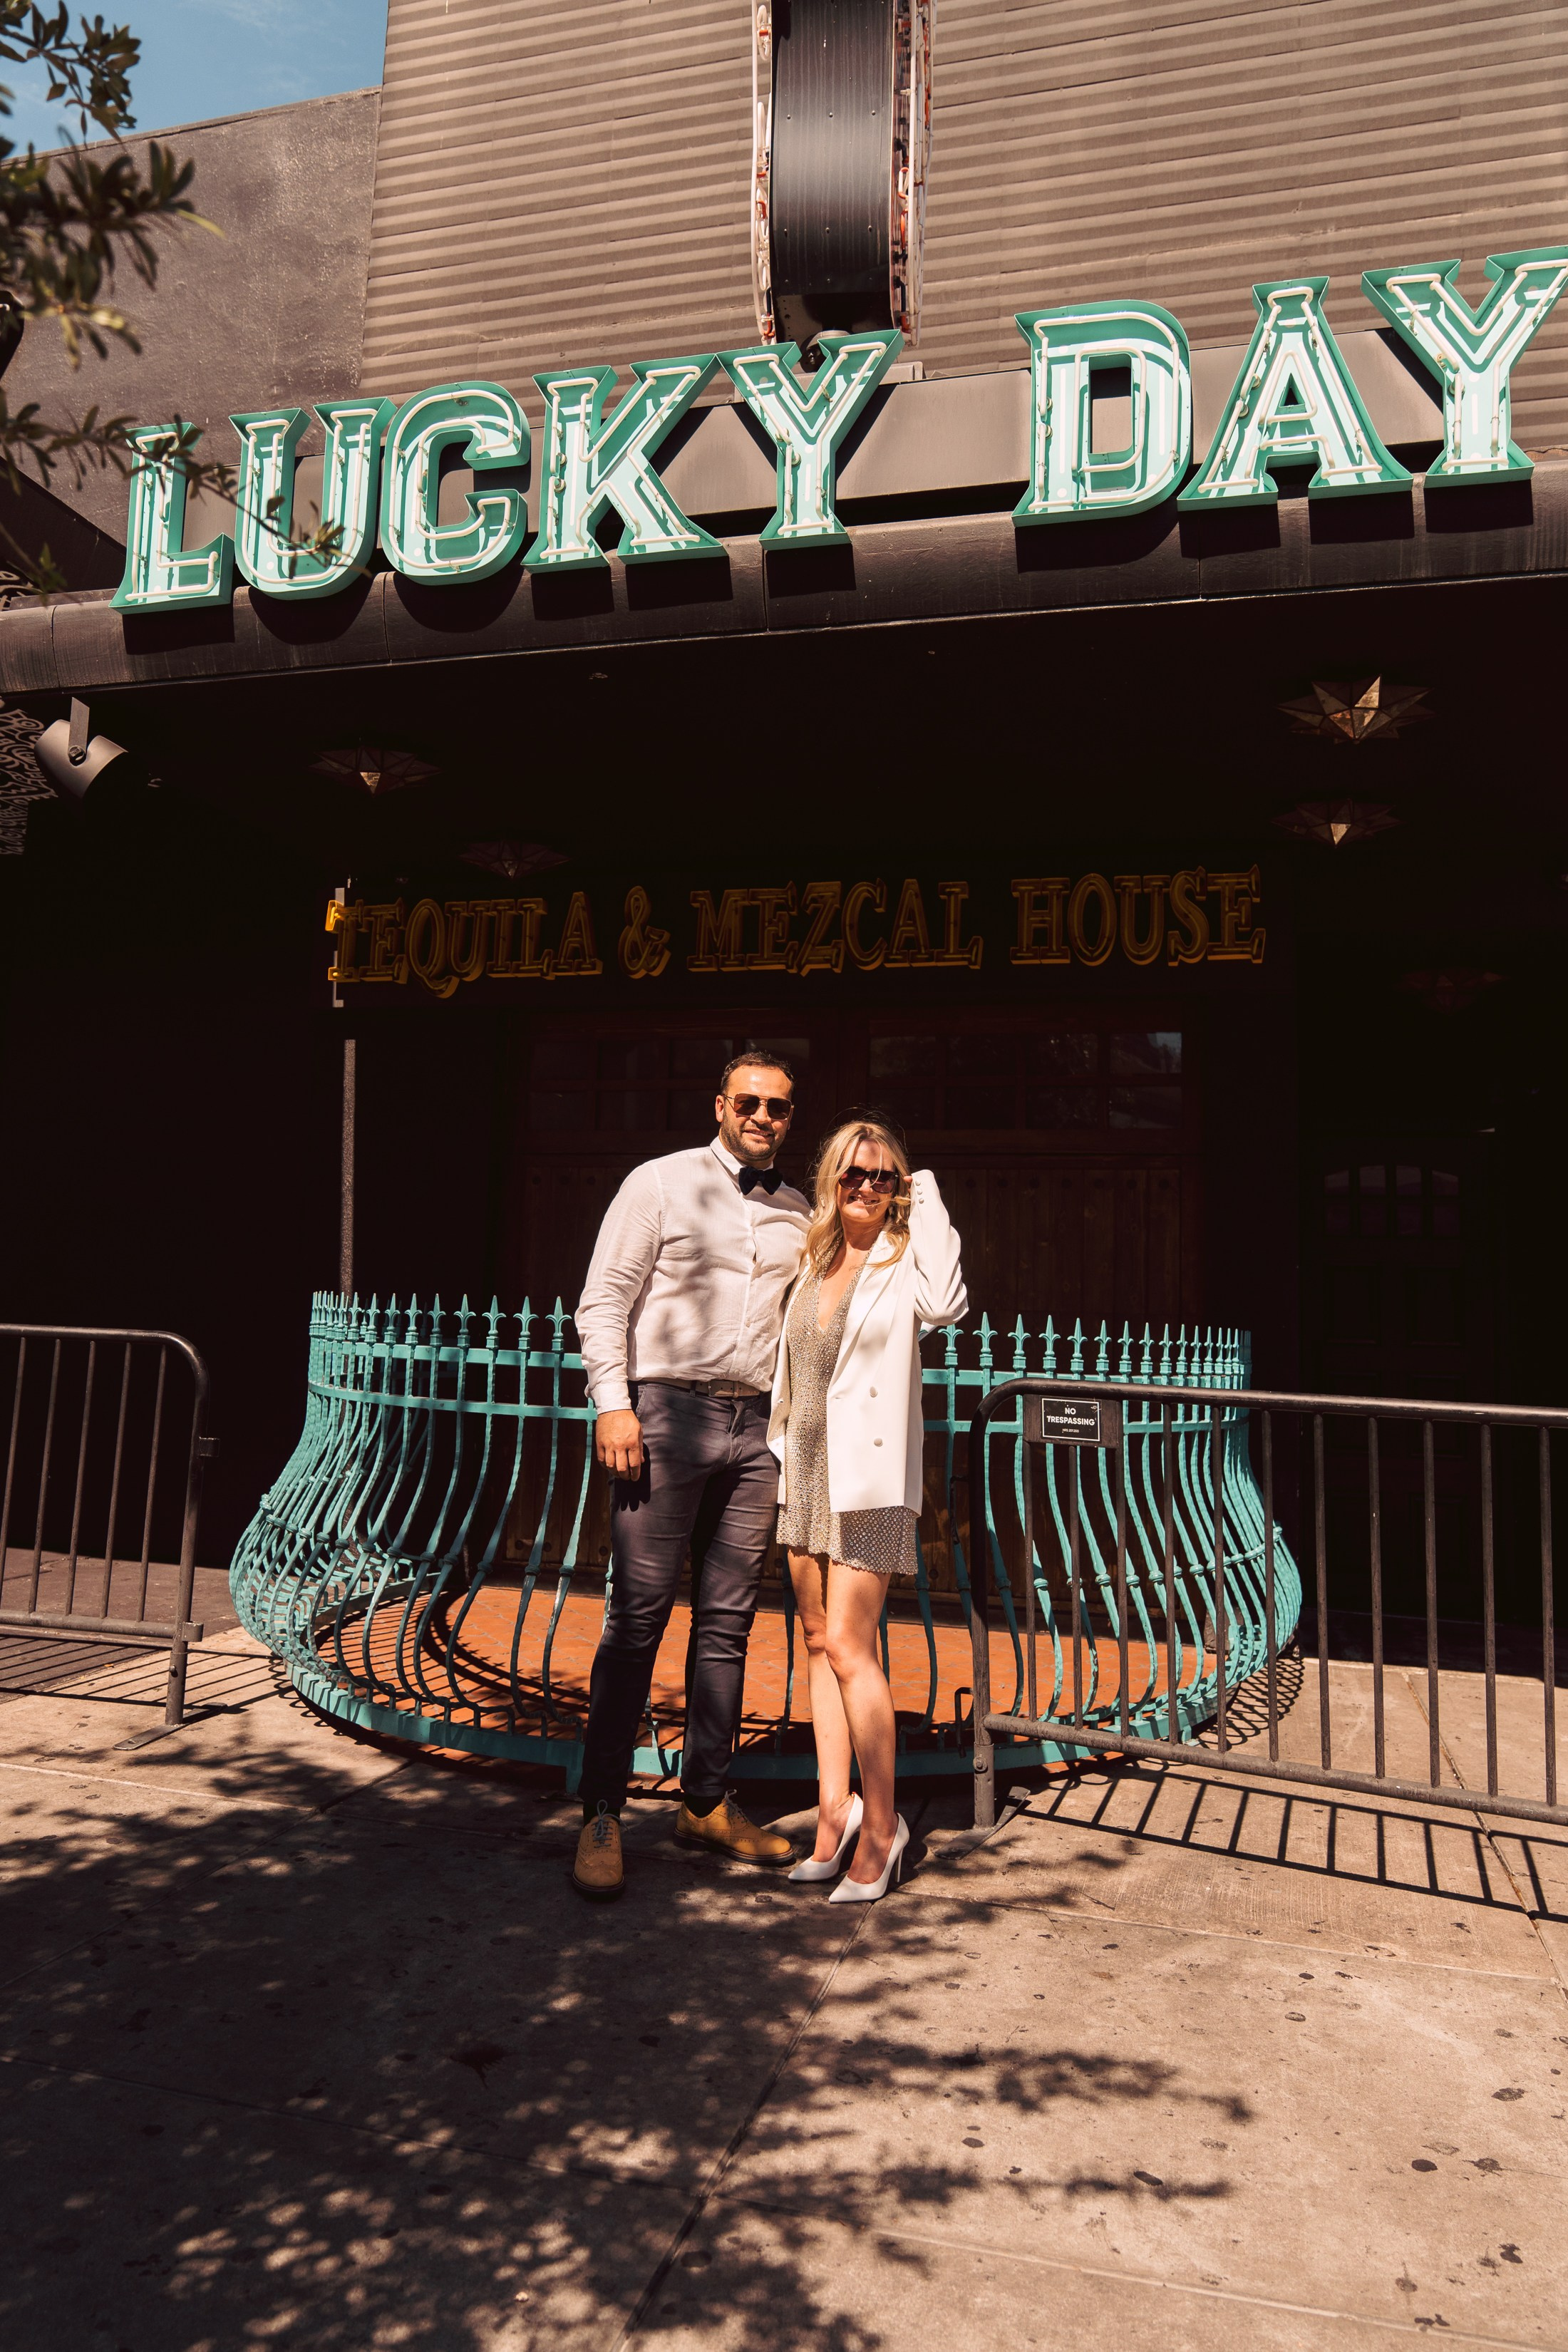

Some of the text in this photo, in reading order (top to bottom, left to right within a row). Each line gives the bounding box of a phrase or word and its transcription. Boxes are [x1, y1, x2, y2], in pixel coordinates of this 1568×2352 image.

[110, 246, 1568, 614] LUCKY DAY
[325, 863, 1267, 999] TEQUILA & MEZCAL HOUSE
[1046, 1415, 1095, 1425] TRESPASSING
